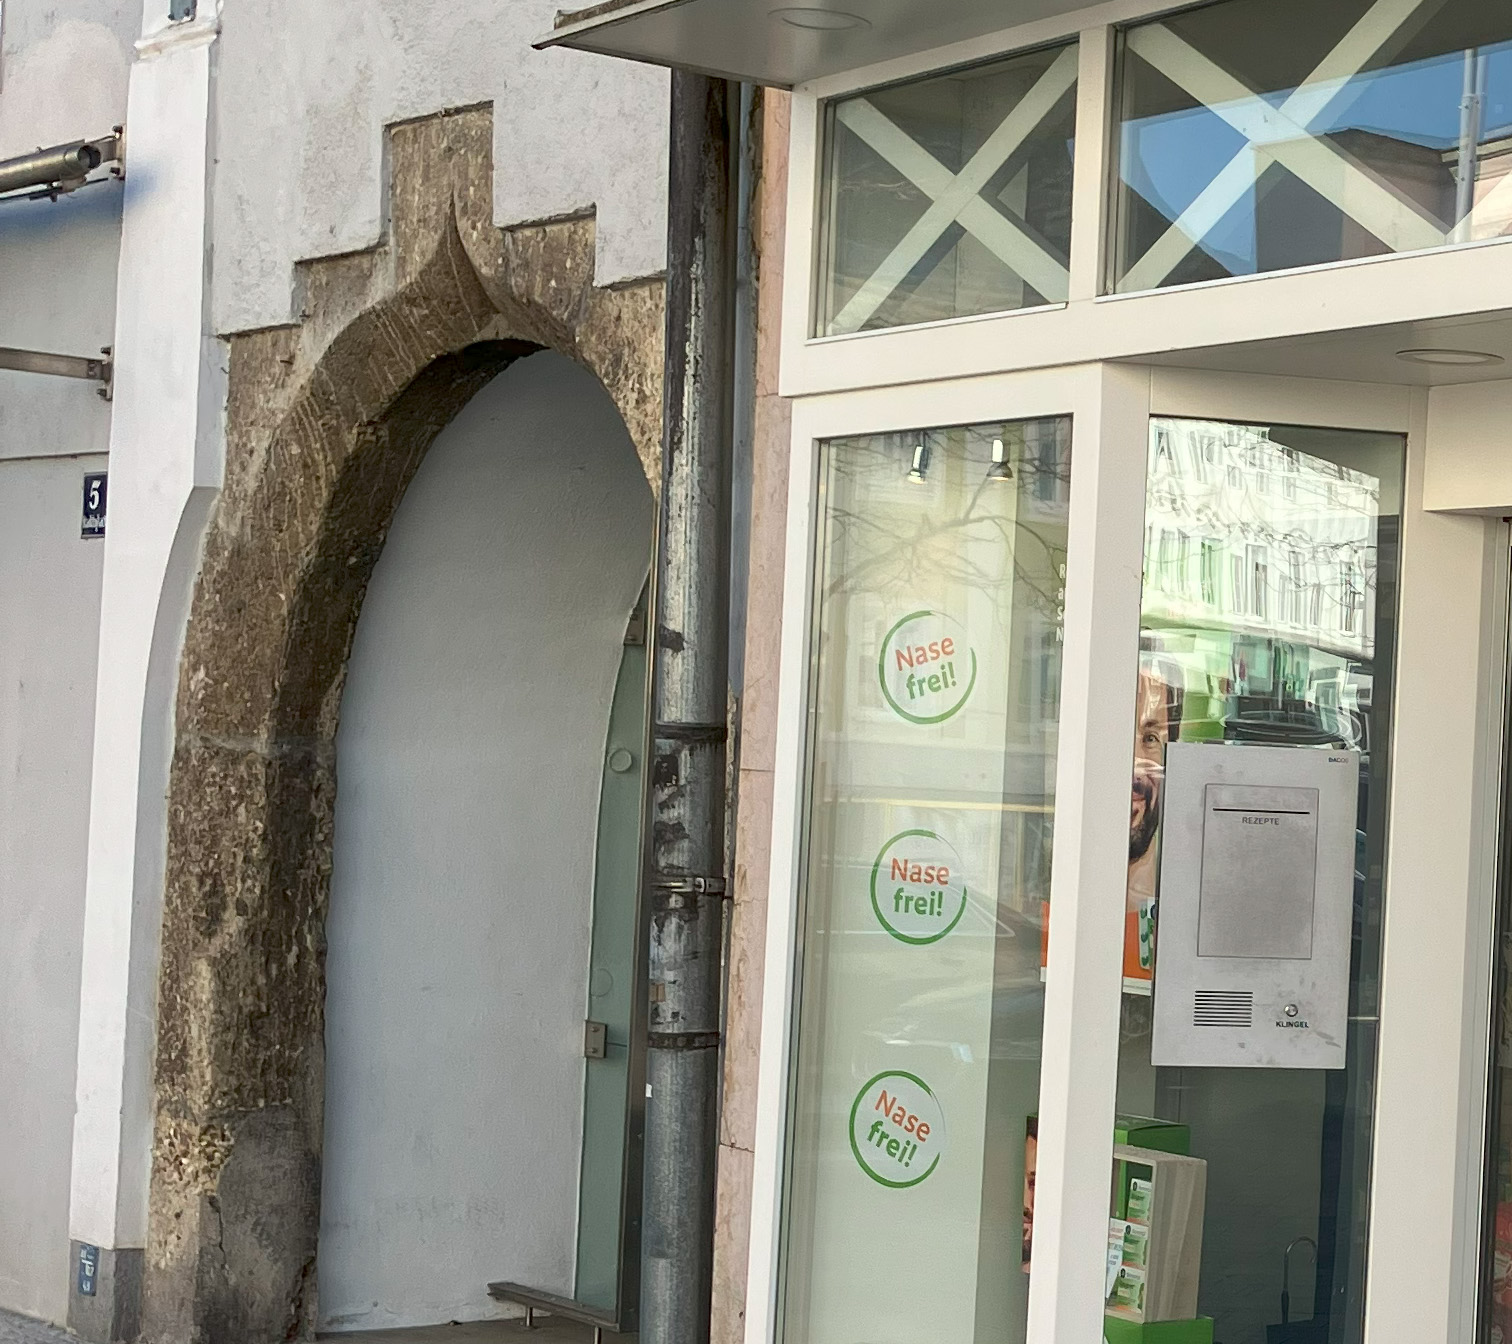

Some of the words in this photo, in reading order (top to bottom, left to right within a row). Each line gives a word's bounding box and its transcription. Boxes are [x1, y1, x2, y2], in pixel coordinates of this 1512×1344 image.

[89, 480, 101, 510] 5
[895, 637, 955, 671] Nase
[906, 662, 957, 700] frei!
[1242, 816, 1280, 825] REZEPTE
[891, 857, 950, 886] Nase
[893, 887, 943, 917] frei!
[875, 1089, 931, 1143] Nase
[867, 1120, 917, 1168] frei!
